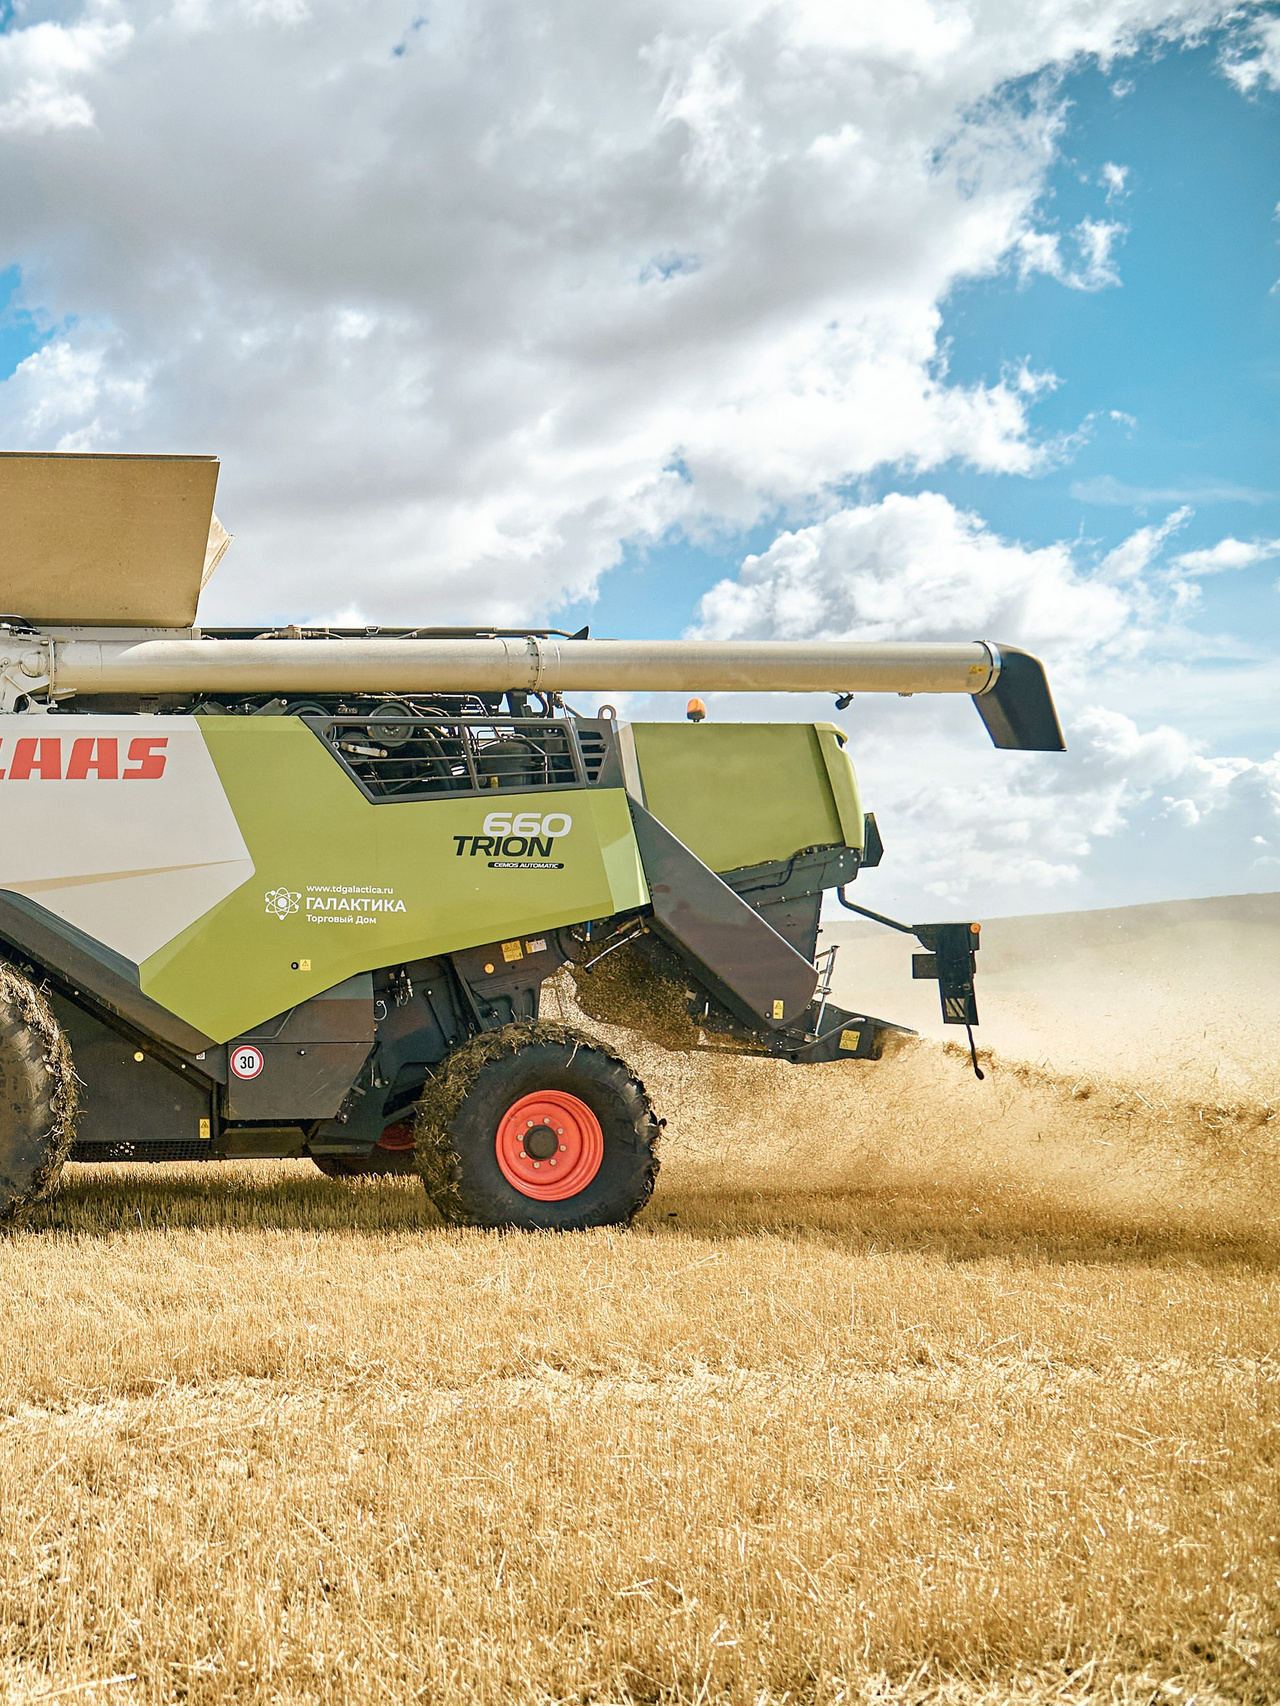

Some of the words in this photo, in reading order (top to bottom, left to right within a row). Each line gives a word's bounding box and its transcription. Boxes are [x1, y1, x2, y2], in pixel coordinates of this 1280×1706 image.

[482, 812, 573, 837] 660
[453, 835, 554, 857] TRION
[306, 884, 394, 895] www.tdgalactica.ru
[306, 896, 407, 913] ГАЛАКТИКА
[306, 914, 354, 924] Торговый
[355, 914, 377, 925] Дом
[239, 1055, 255, 1069] 30
